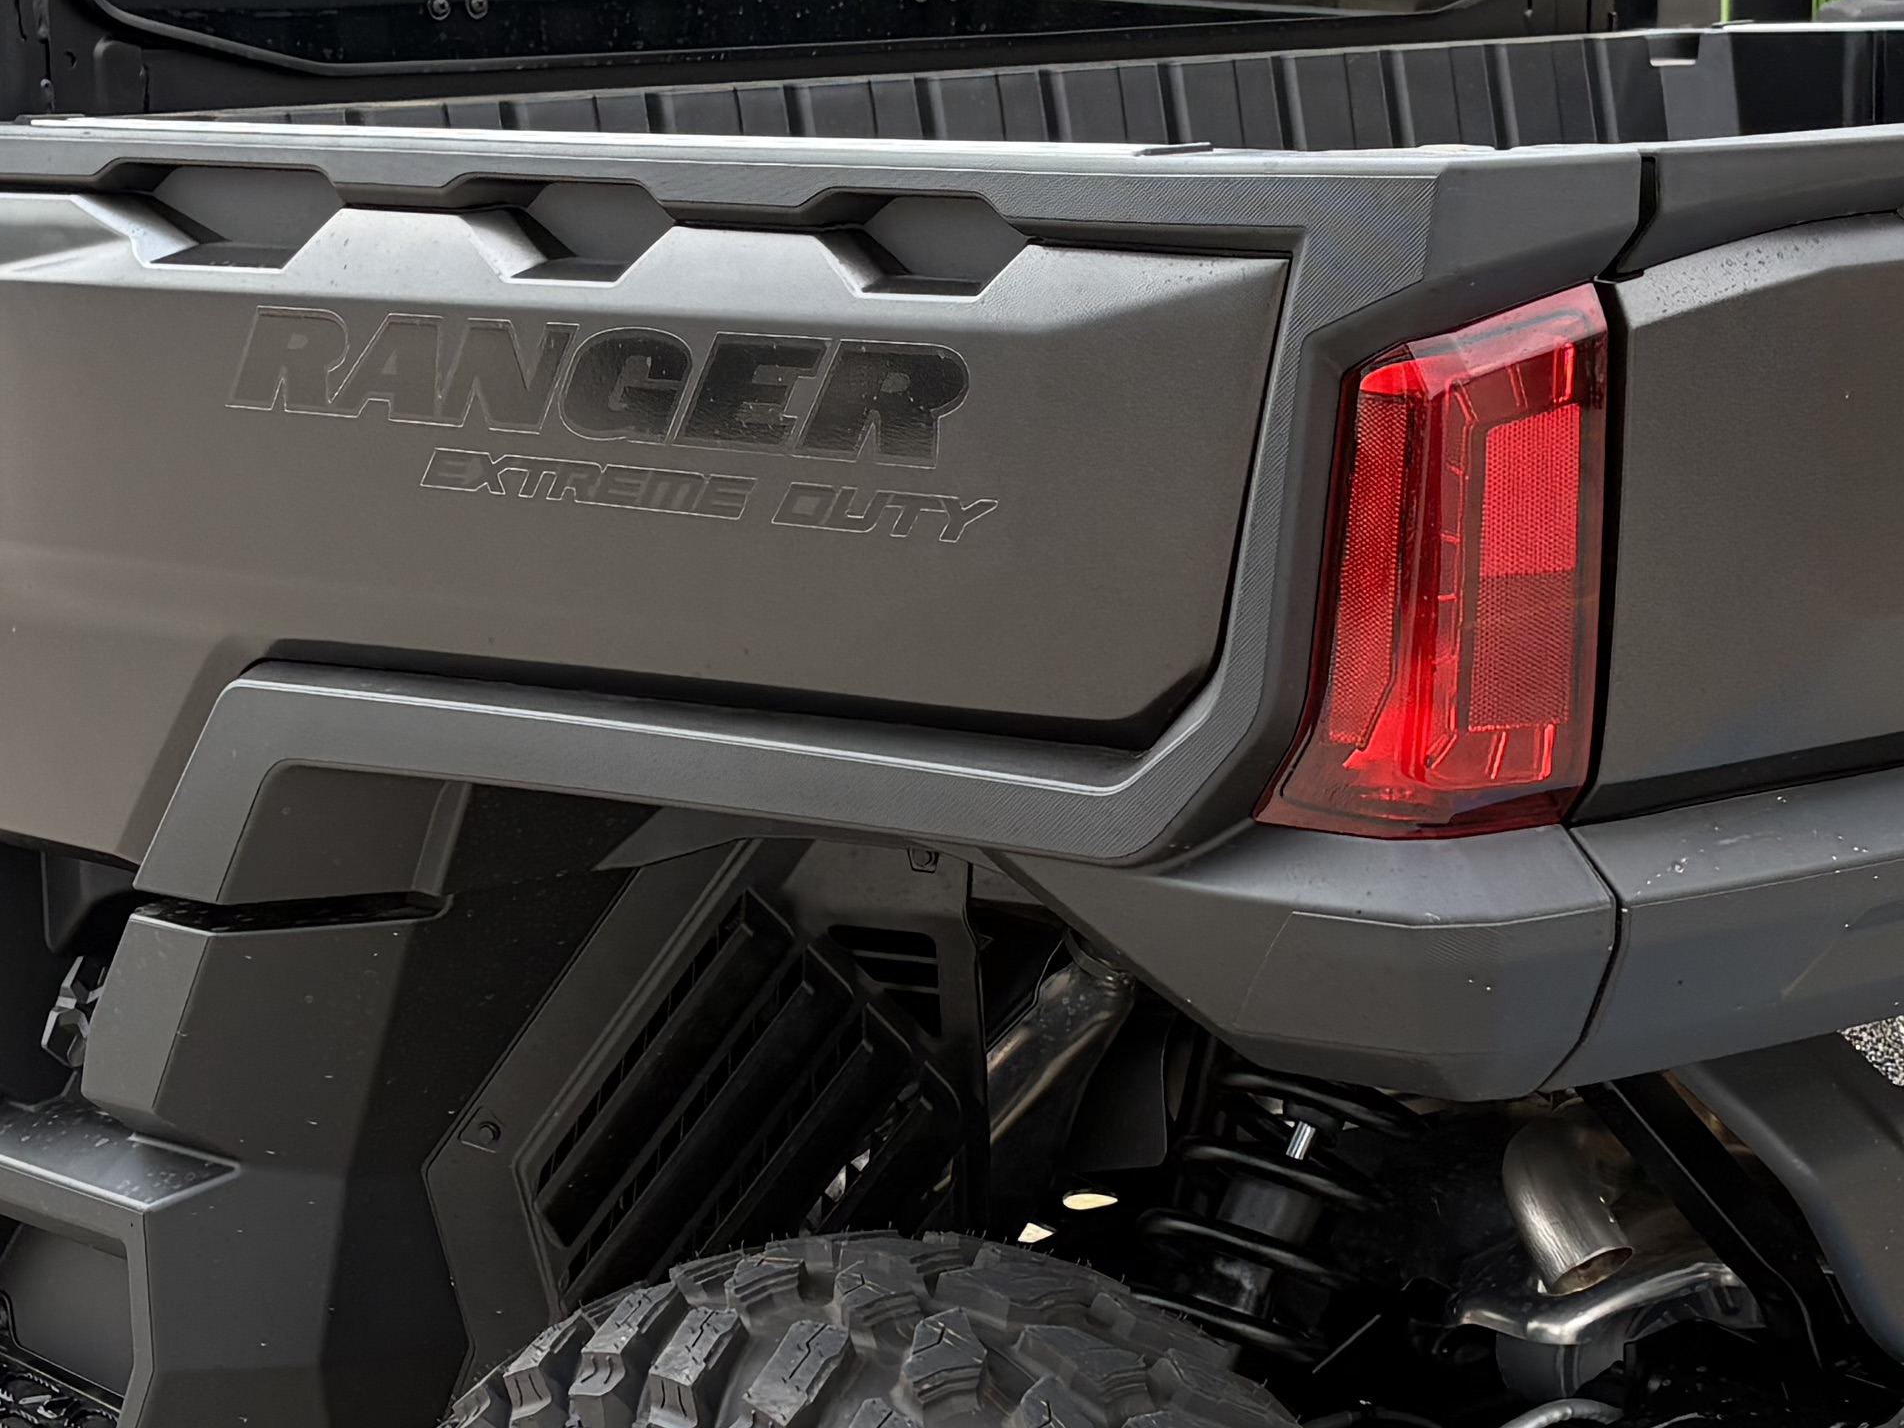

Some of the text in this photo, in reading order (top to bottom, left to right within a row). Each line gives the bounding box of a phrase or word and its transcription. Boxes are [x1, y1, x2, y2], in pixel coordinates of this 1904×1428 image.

[227, 305, 970, 468] RANGER
[419, 447, 998, 544] EXTREME DUTY
